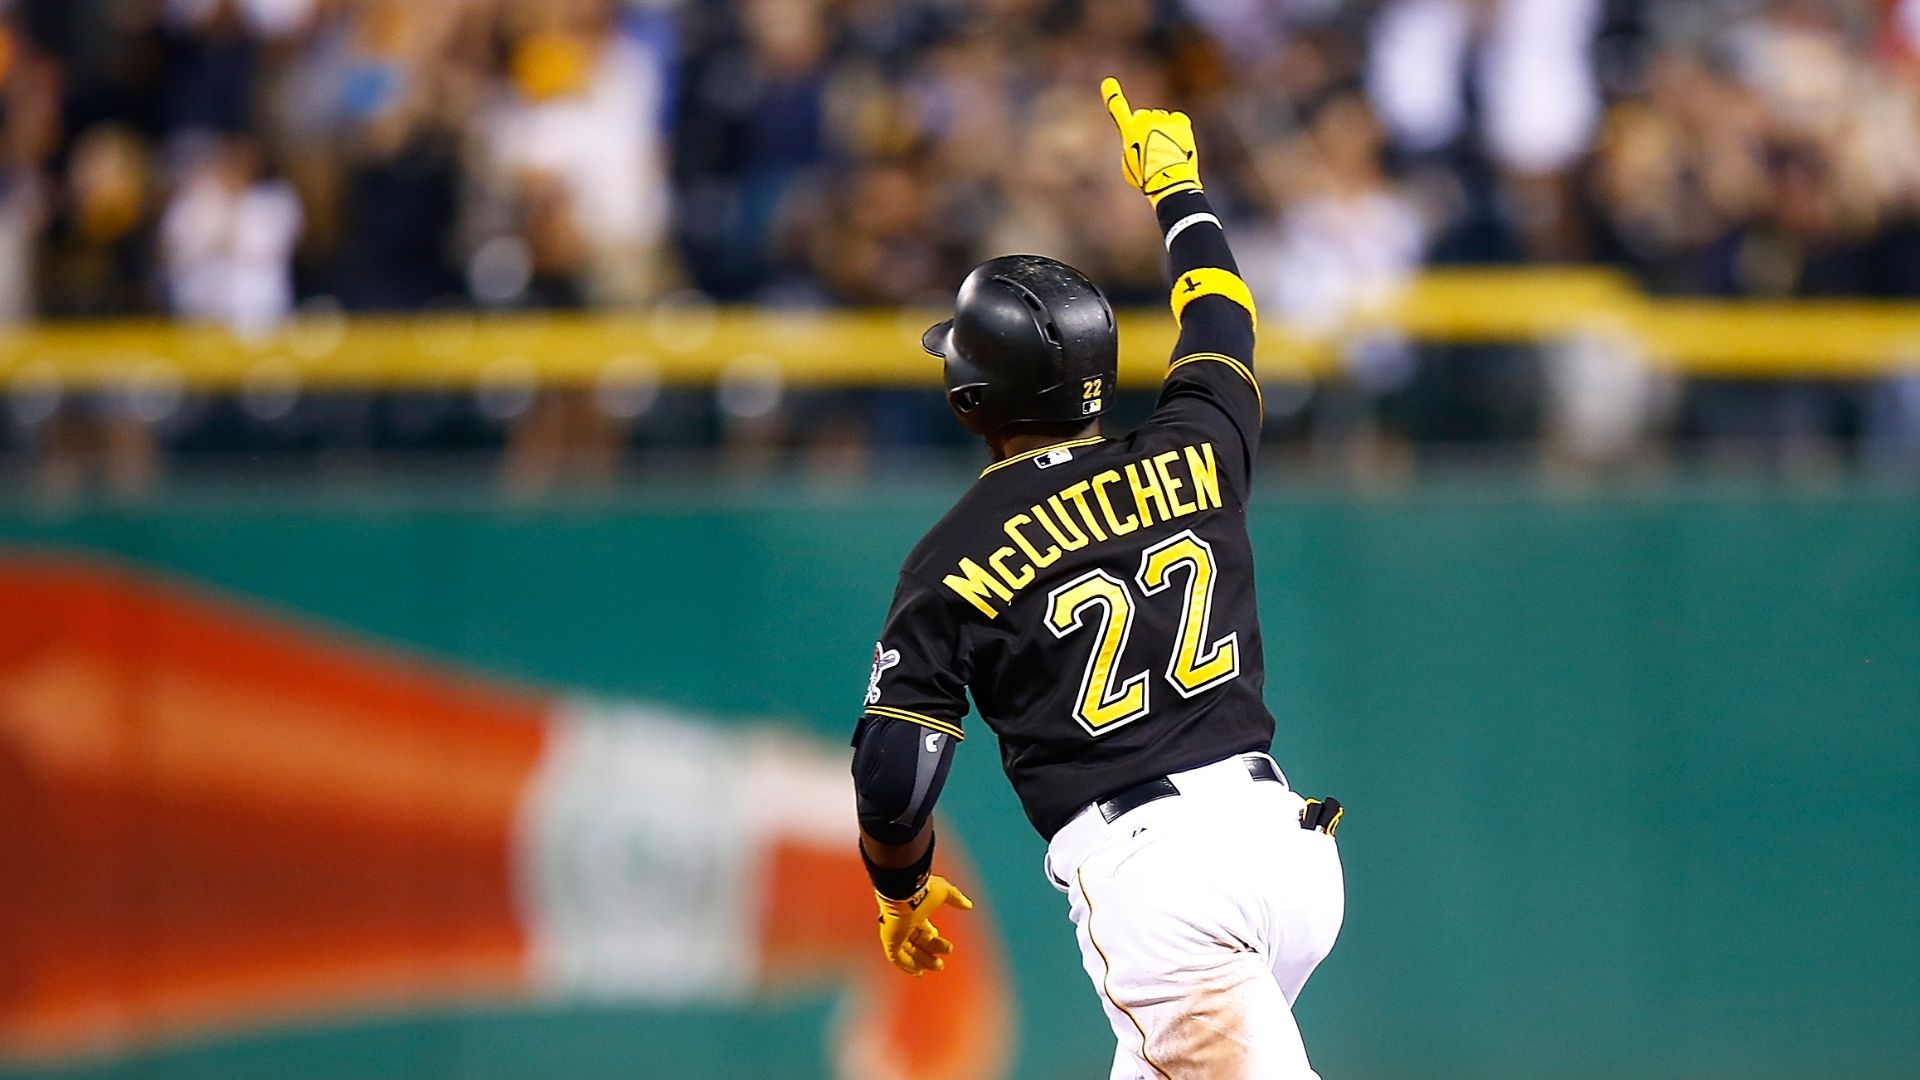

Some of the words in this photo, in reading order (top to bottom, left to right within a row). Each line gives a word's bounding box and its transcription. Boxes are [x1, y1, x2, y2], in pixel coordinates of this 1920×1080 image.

[1083, 379, 1102, 399] 22
[943, 443, 1222, 619] McCUTCHEN
[1043, 529, 1240, 737] 22
